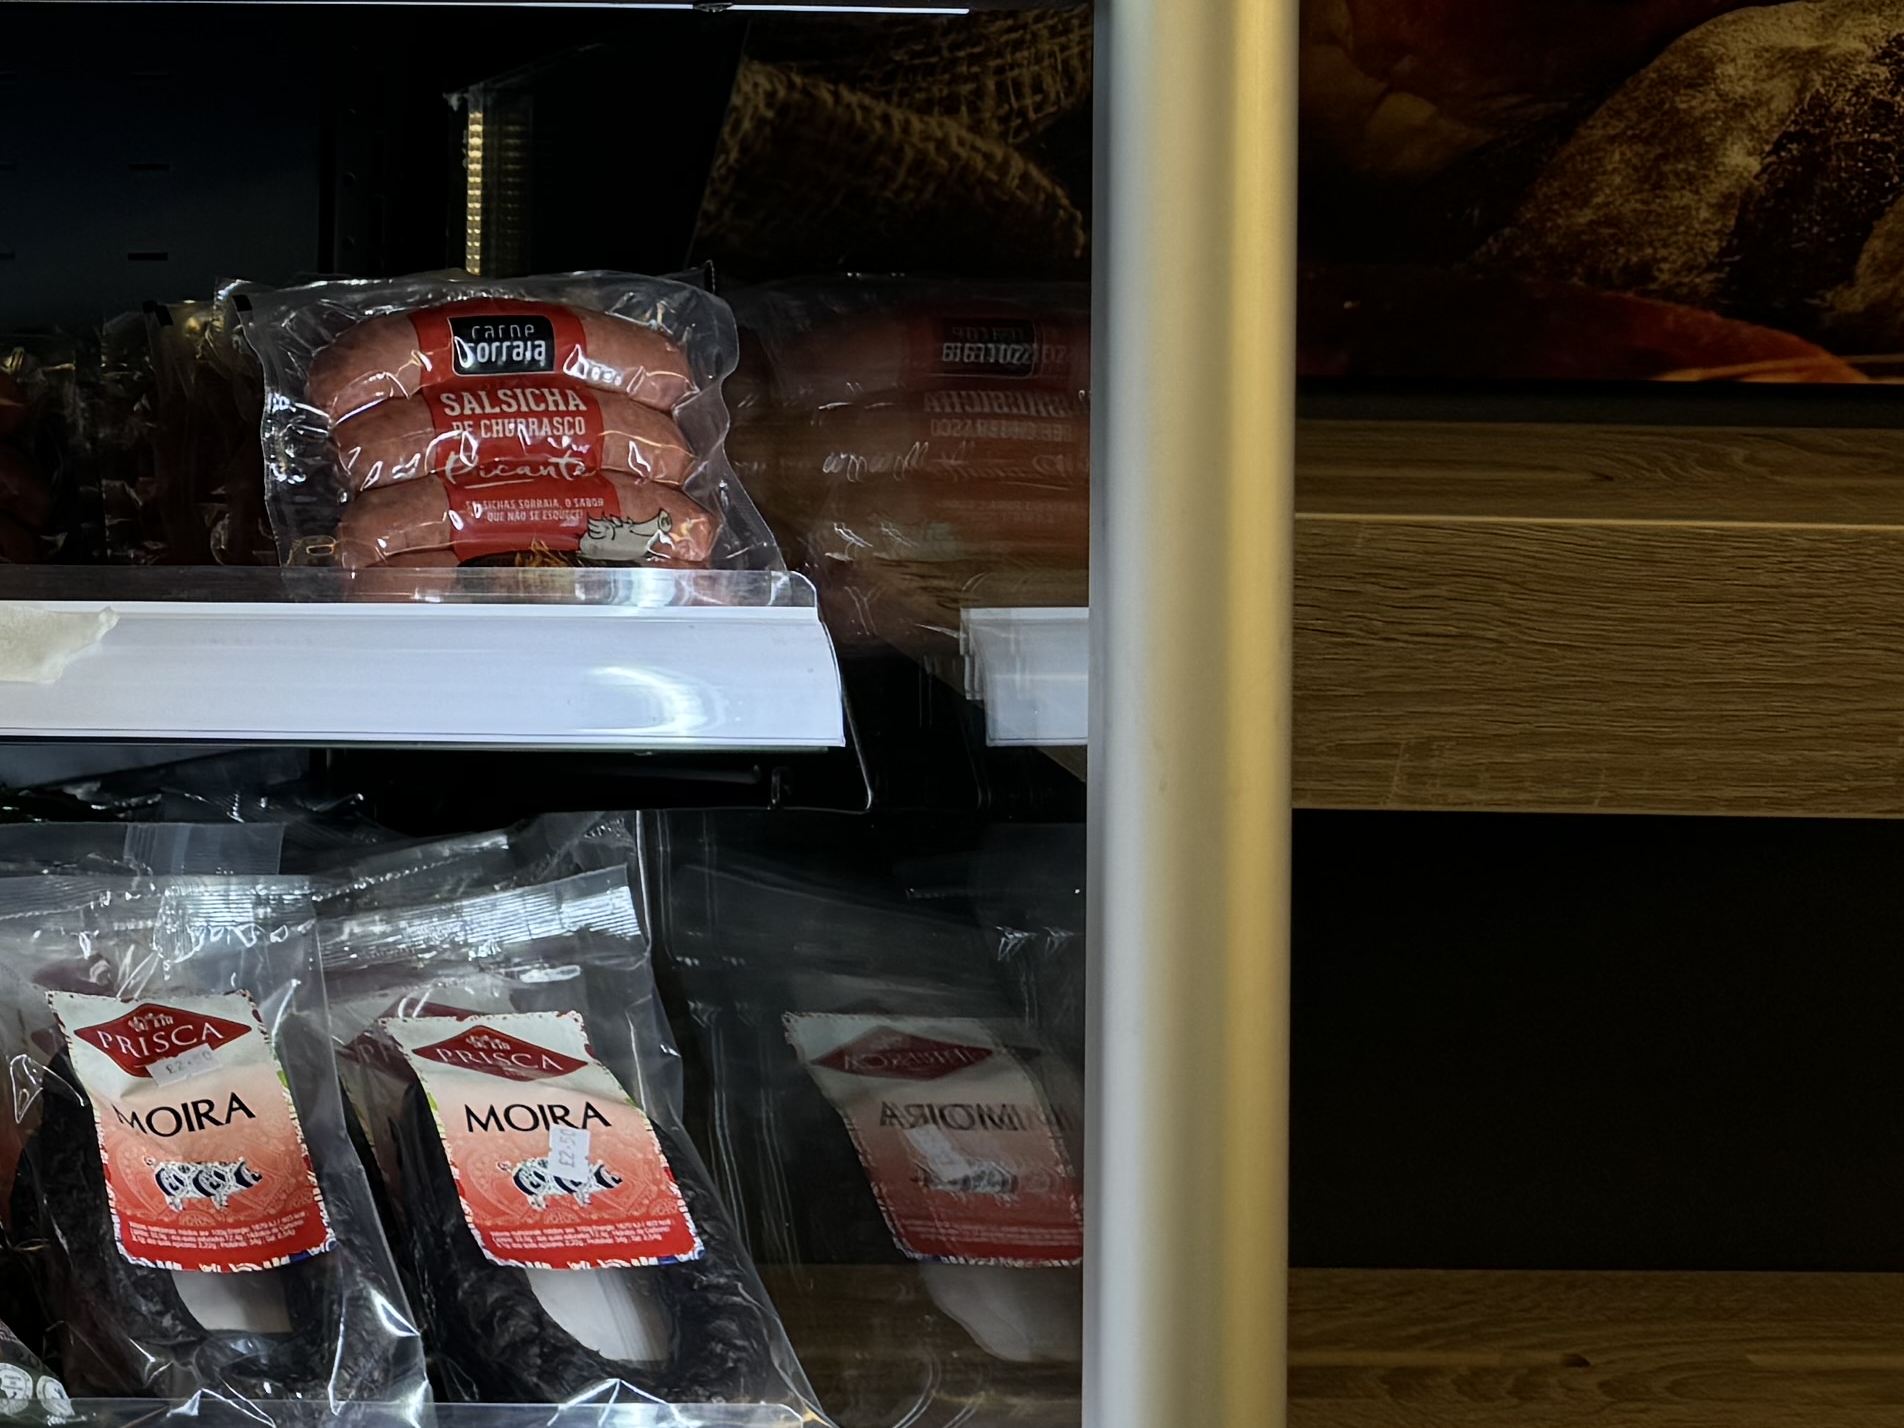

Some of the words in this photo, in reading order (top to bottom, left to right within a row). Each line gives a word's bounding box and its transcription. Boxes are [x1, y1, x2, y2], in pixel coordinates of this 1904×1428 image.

[471, 323, 535, 340] carne
[440, 388, 588, 416] SALSICHA
[452, 420, 473, 438] DE
[480, 416, 587, 439] CHURRASCO
[96, 1021, 226, 1060] PRISCA
[434, 1046, 562, 1073] PRISCA
[111, 1090, 257, 1139] MOIRA
[464, 1100, 613, 1133] MOIRA
[558, 1127, 577, 1171] £2.50
